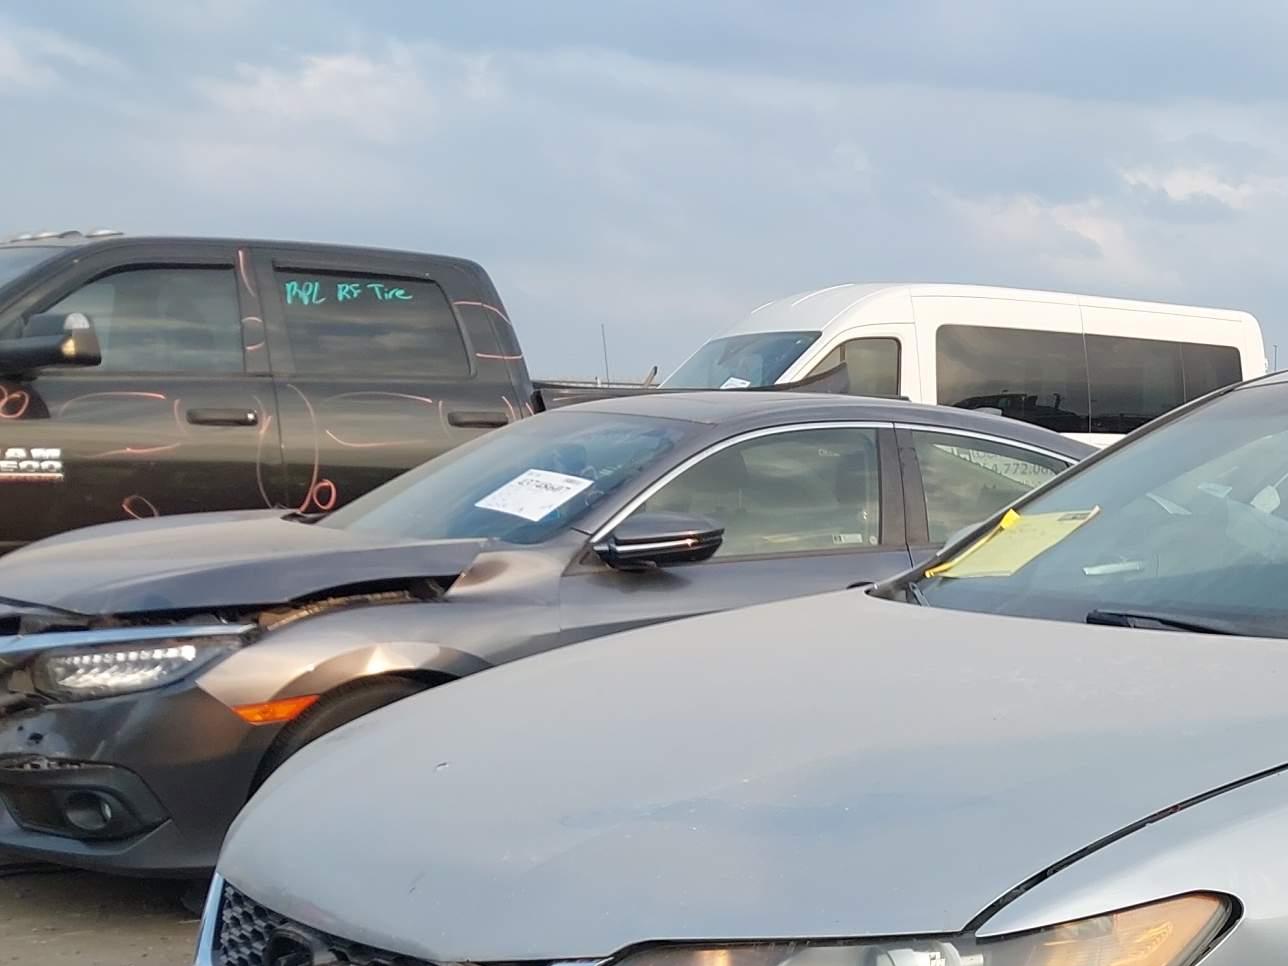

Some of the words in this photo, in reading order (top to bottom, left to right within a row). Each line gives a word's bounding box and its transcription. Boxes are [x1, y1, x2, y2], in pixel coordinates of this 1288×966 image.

[366, 283, 413, 300] Tire
[0, 447, 62, 460] AM
[0, 460, 63, 473] 500
